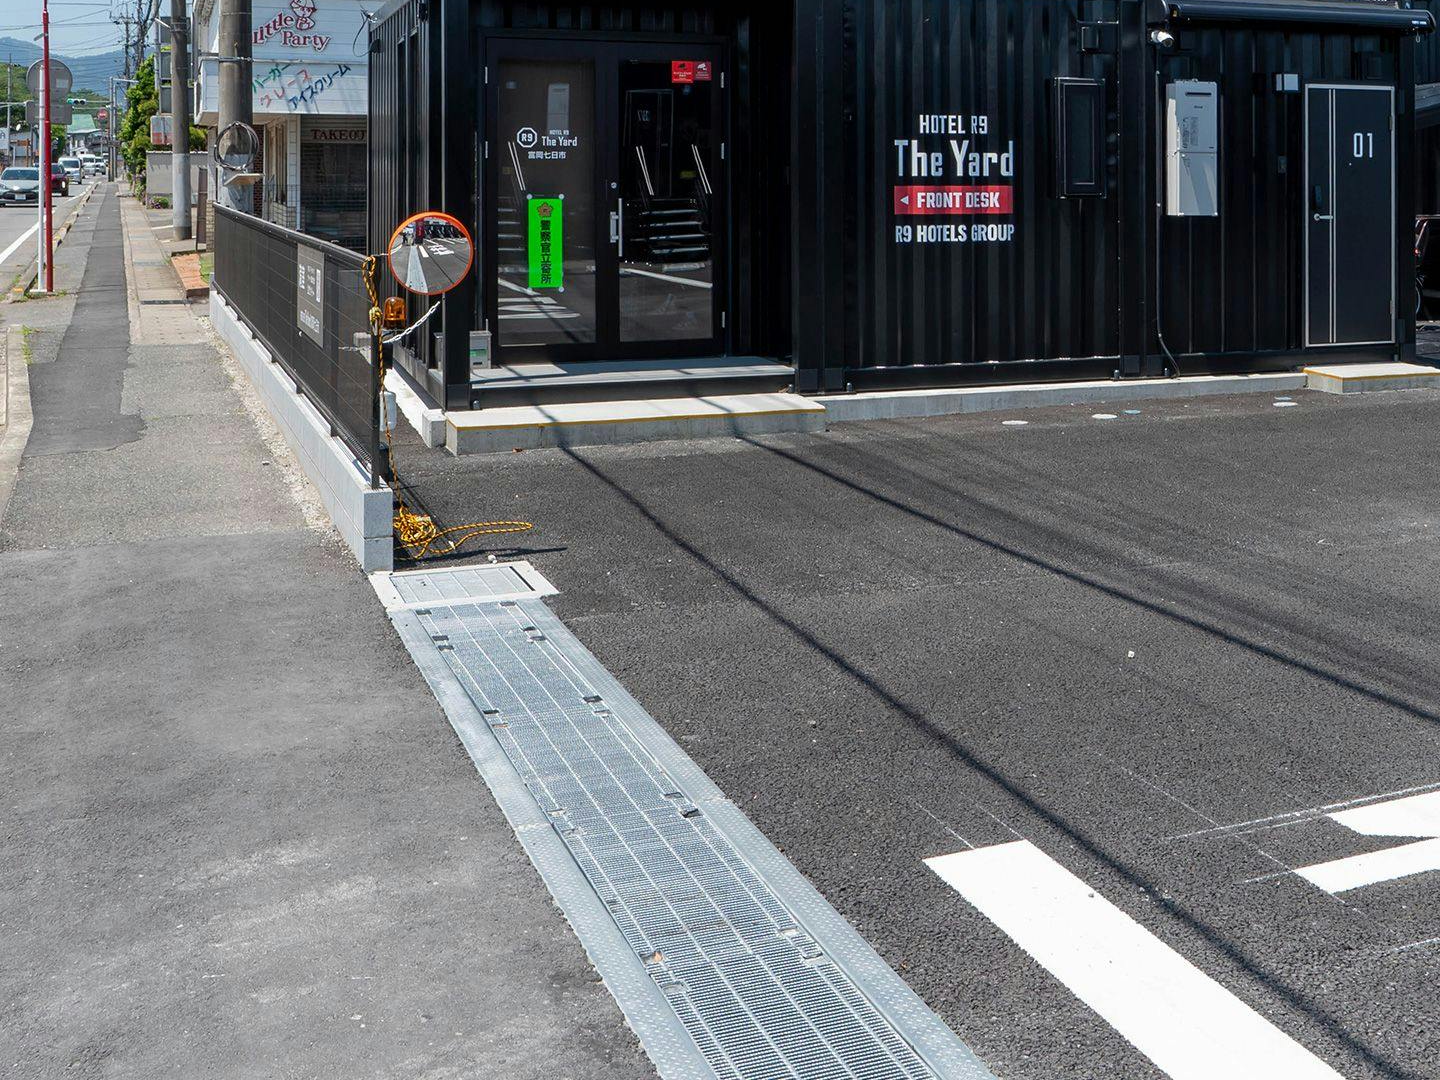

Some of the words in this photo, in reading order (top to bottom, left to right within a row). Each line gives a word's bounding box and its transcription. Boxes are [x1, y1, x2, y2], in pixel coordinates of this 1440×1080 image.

[252, 11, 294, 45] Little
[282, 30, 330, 50] Party
[288, 64, 351, 110] アイスクリーム
[310, 128, 348, 140] TAKE
[919, 114, 966, 134] HOTEL
[971, 115, 988, 134] R9
[521, 133, 533, 142] R9
[541, 135, 557, 147] The
[558, 136, 578, 147] Yard
[1353, 132, 1373, 158] 01
[894, 139, 943, 177] The
[950, 140, 1014, 177] Yard
[917, 191, 962, 208] FRONT
[965, 191, 1000, 208] DESK
[895, 224, 912, 243] R9
[916, 224, 968, 243] HOTELS
[971, 223, 1015, 241] GROUP
